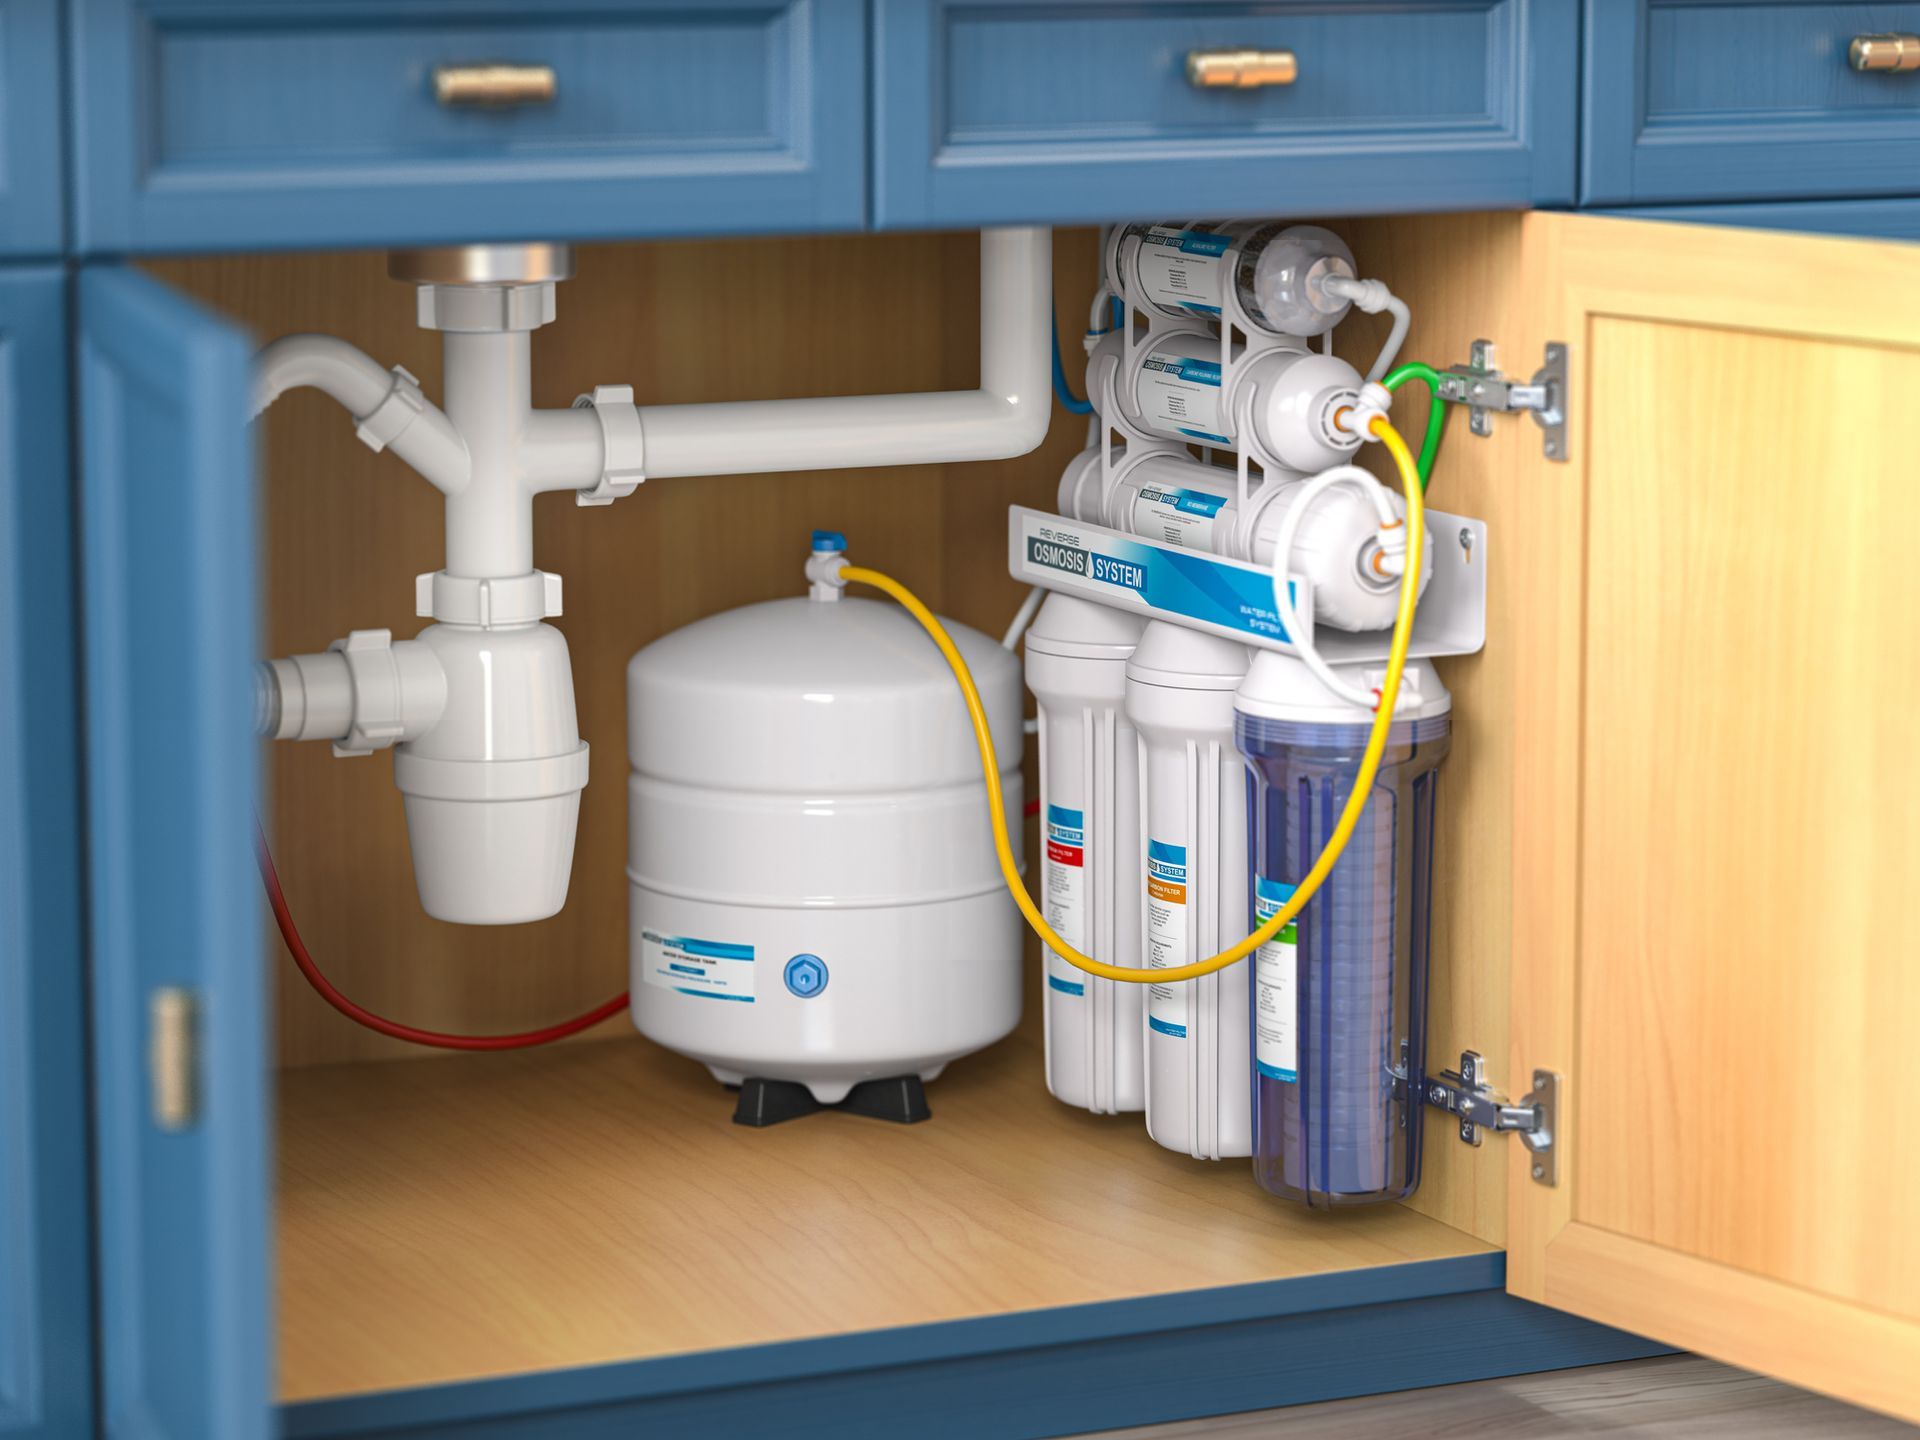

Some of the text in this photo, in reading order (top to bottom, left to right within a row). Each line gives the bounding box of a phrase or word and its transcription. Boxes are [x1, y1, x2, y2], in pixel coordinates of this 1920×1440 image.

[1167, 238, 1184, 247] SYSTEM
[1145, 361, 1183, 374] OSMOSIS SYSTEM
[1142, 490, 1180, 505] OSMOSIS SYSTEM
[1040, 528, 1080, 546] REVERSE
[1034, 542, 1142, 588] OSMOSIS SYSTEM
[1250, 618, 1281, 634] SYSTEM
[1160, 865, 1184, 876] SYSTEM
[1164, 887, 1181, 896] FILTER
